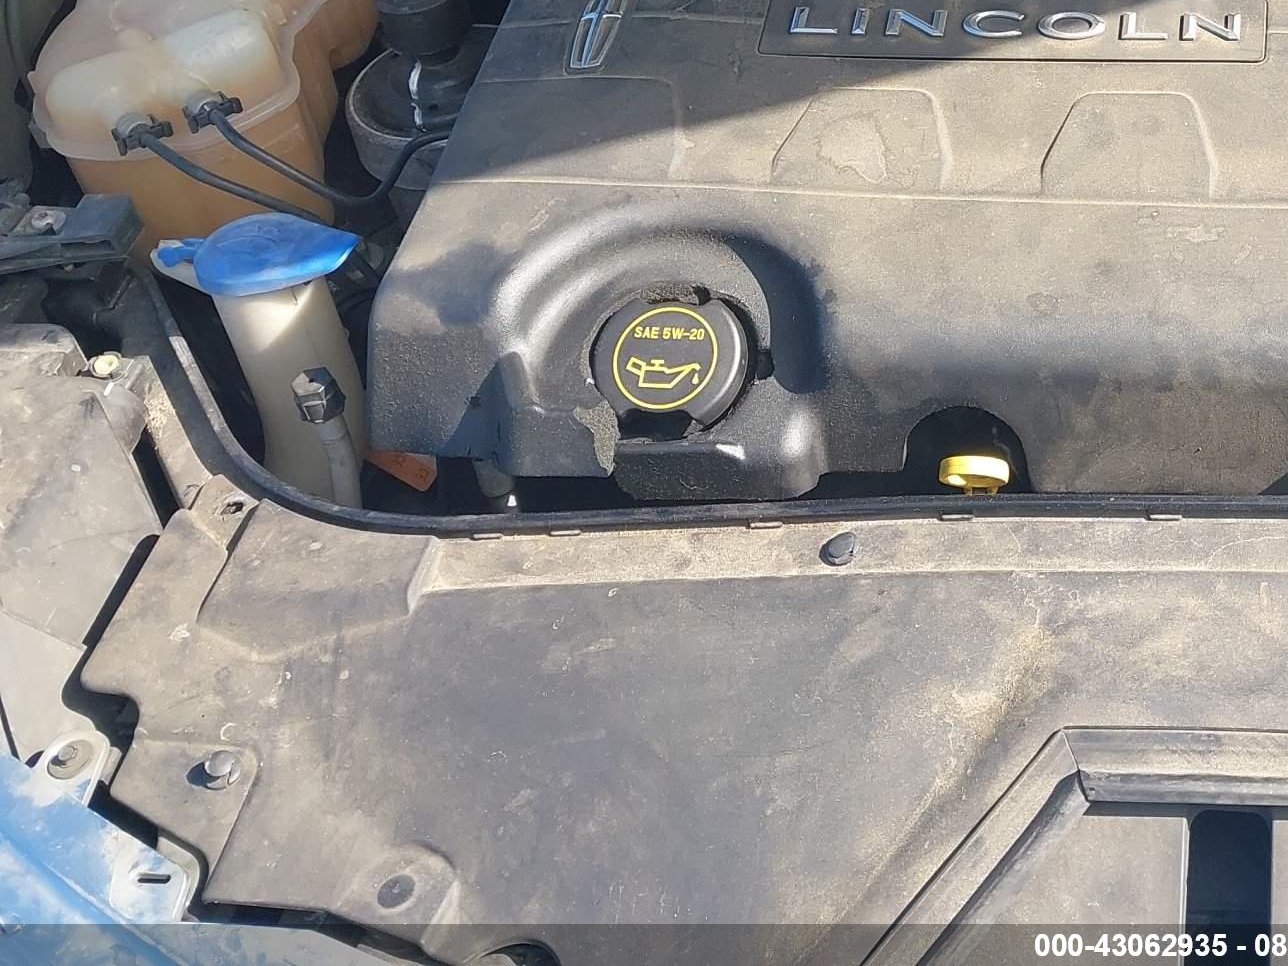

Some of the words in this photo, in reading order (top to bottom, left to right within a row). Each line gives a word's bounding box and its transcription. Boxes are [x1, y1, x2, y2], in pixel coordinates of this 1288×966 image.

[788, 5, 1242, 42] LINCOLN
[633, 326, 659, 339] SAE
[662, 327, 706, 340] 5W-20
